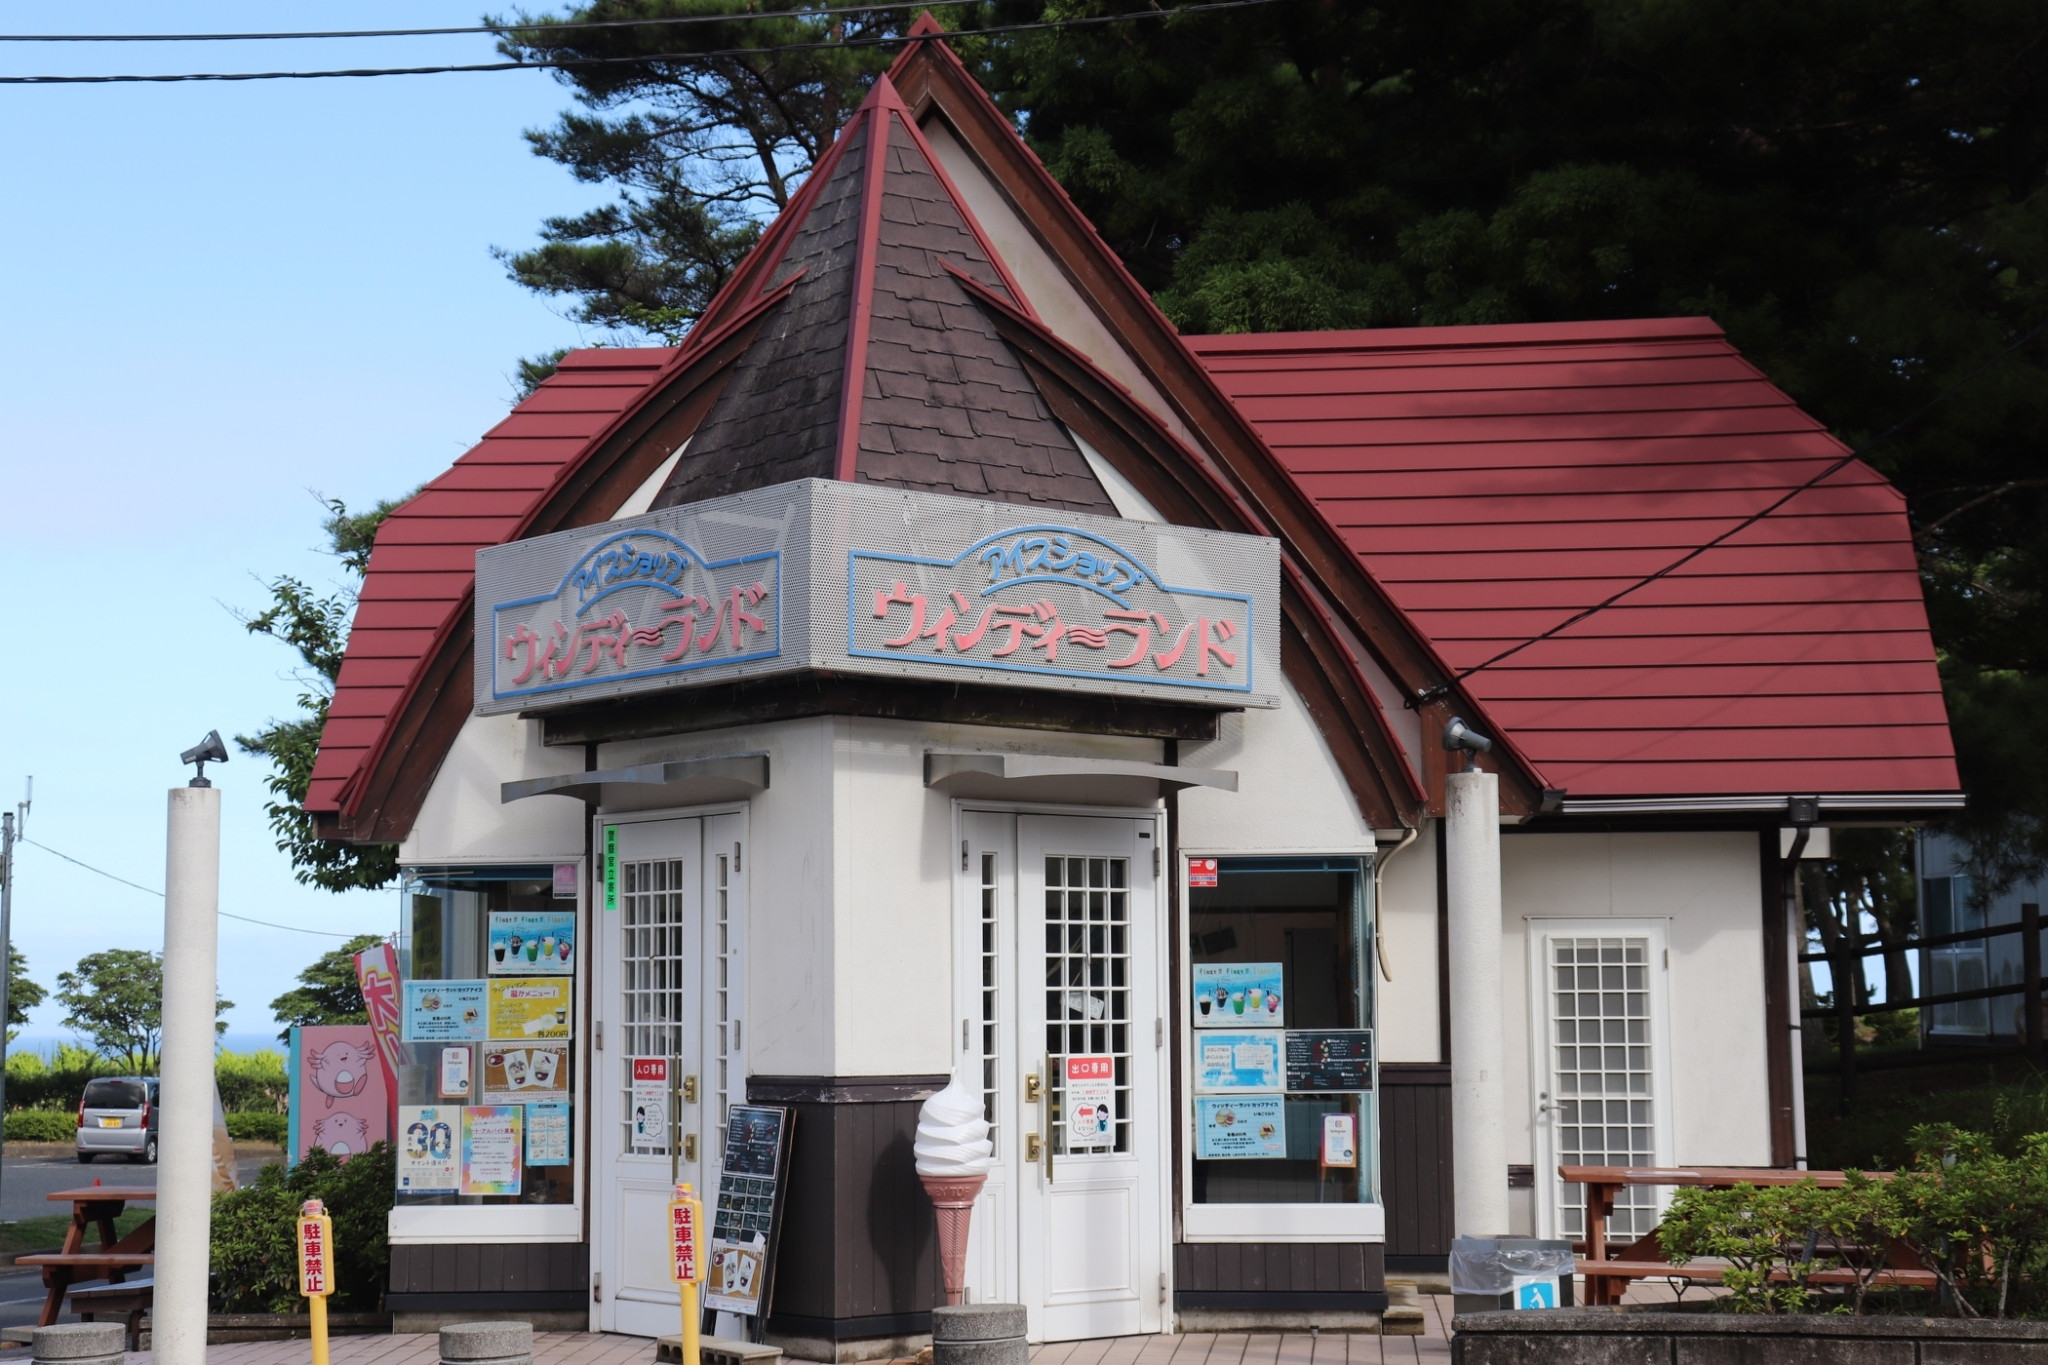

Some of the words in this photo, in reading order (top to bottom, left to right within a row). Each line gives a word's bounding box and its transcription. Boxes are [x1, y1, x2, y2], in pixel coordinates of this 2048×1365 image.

[572, 543, 691, 602] アイスショップ
[980, 535, 1146, 593] アイスショップ
[504, 581, 768, 685] ウィンディーランド
[873, 579, 1238, 677] ウィンディーランド
[636, 1064, 664, 1076] 入口専用
[1071, 1062, 1109, 1074] 出口専用
[949, 1186, 971, 1197] TOP
[304, 1223, 323, 1293] 駐車禁止
[674, 1207, 694, 1280] 駐車禁止
